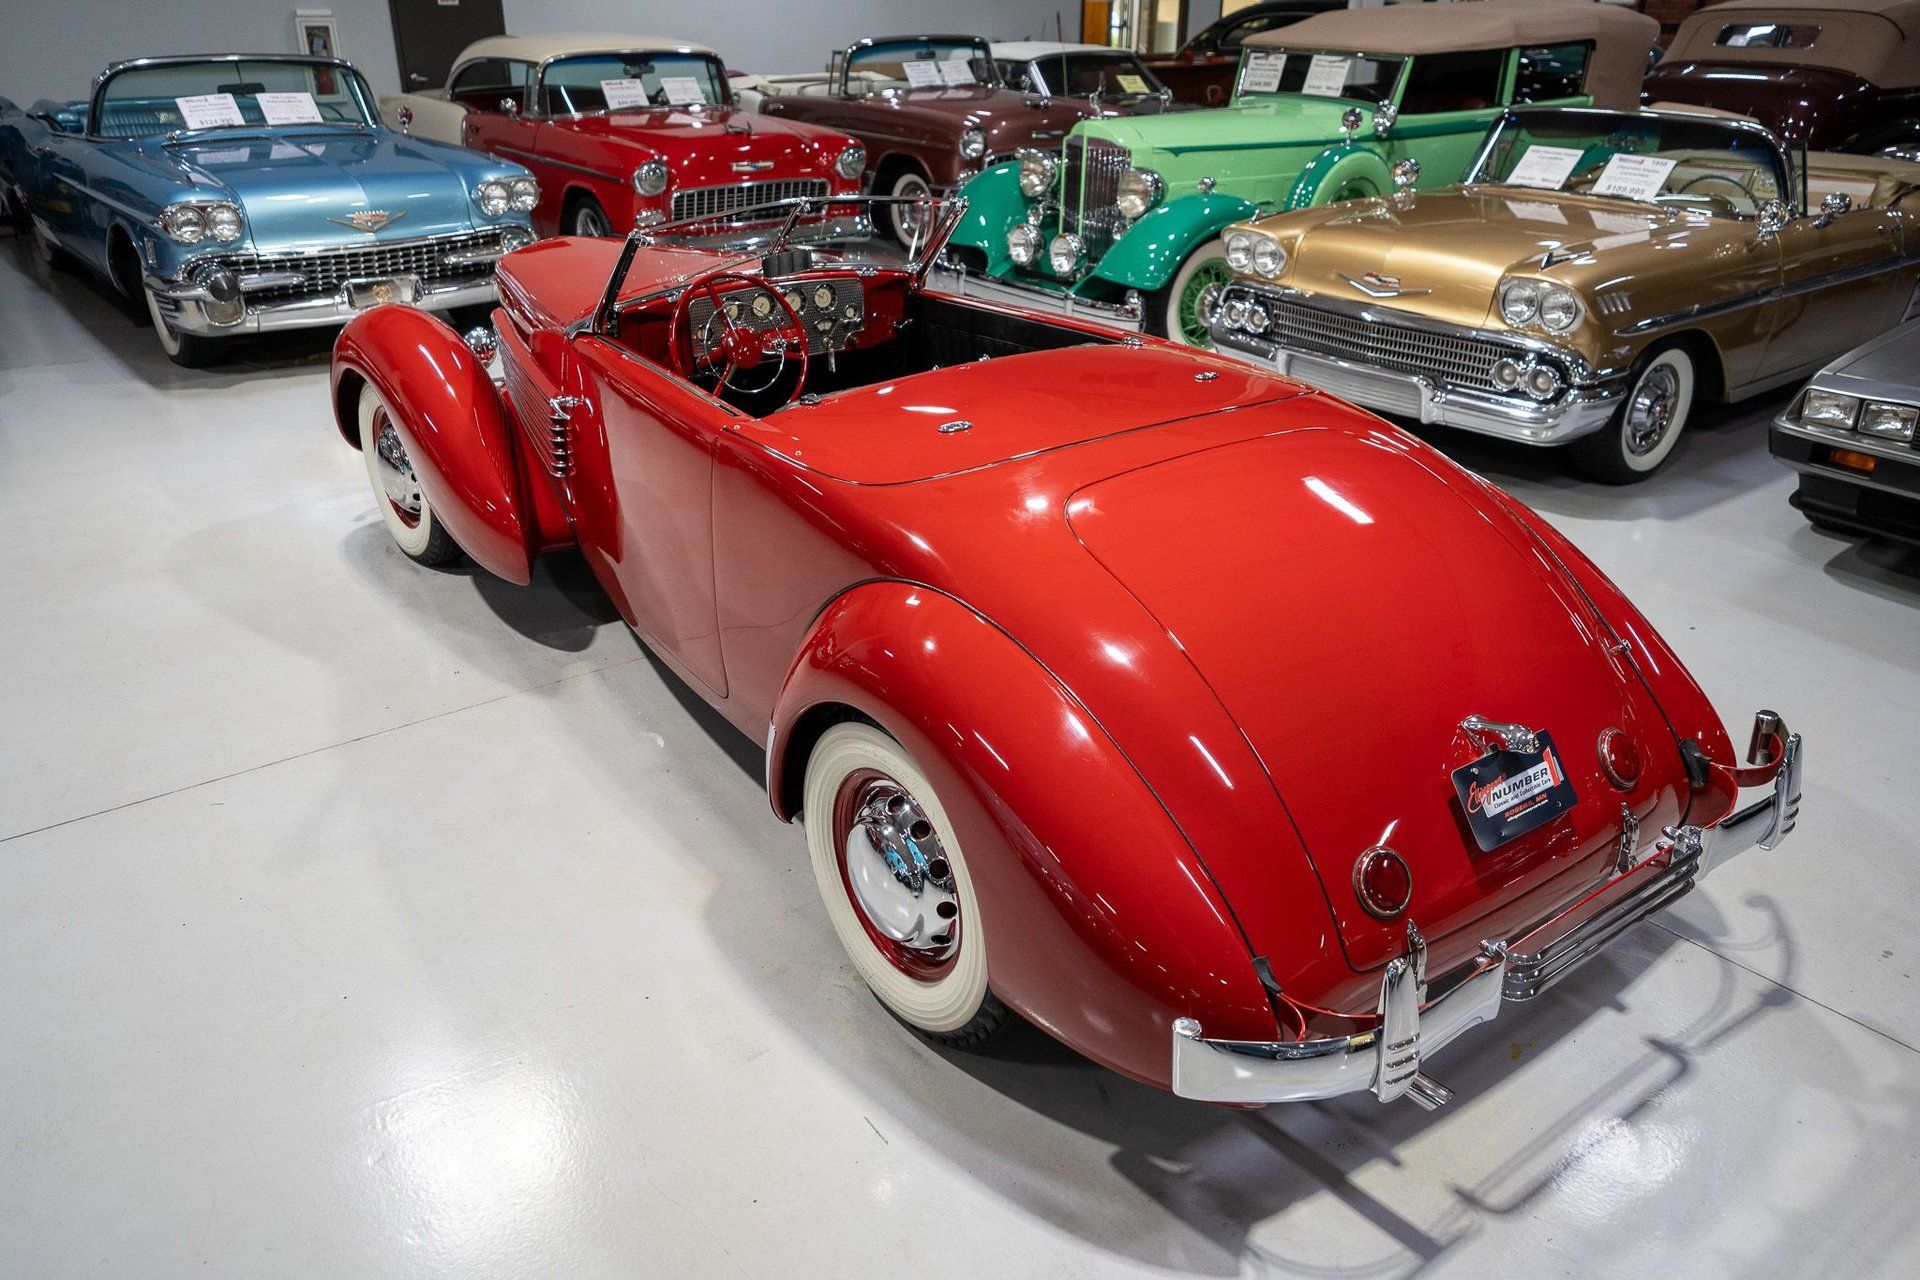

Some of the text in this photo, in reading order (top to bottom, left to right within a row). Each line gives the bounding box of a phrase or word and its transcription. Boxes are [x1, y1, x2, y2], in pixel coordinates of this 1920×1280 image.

[1491, 767, 1549, 802] NUMBER
[1510, 793, 1520, 802] and
[1535, 792, 1548, 802] MN
